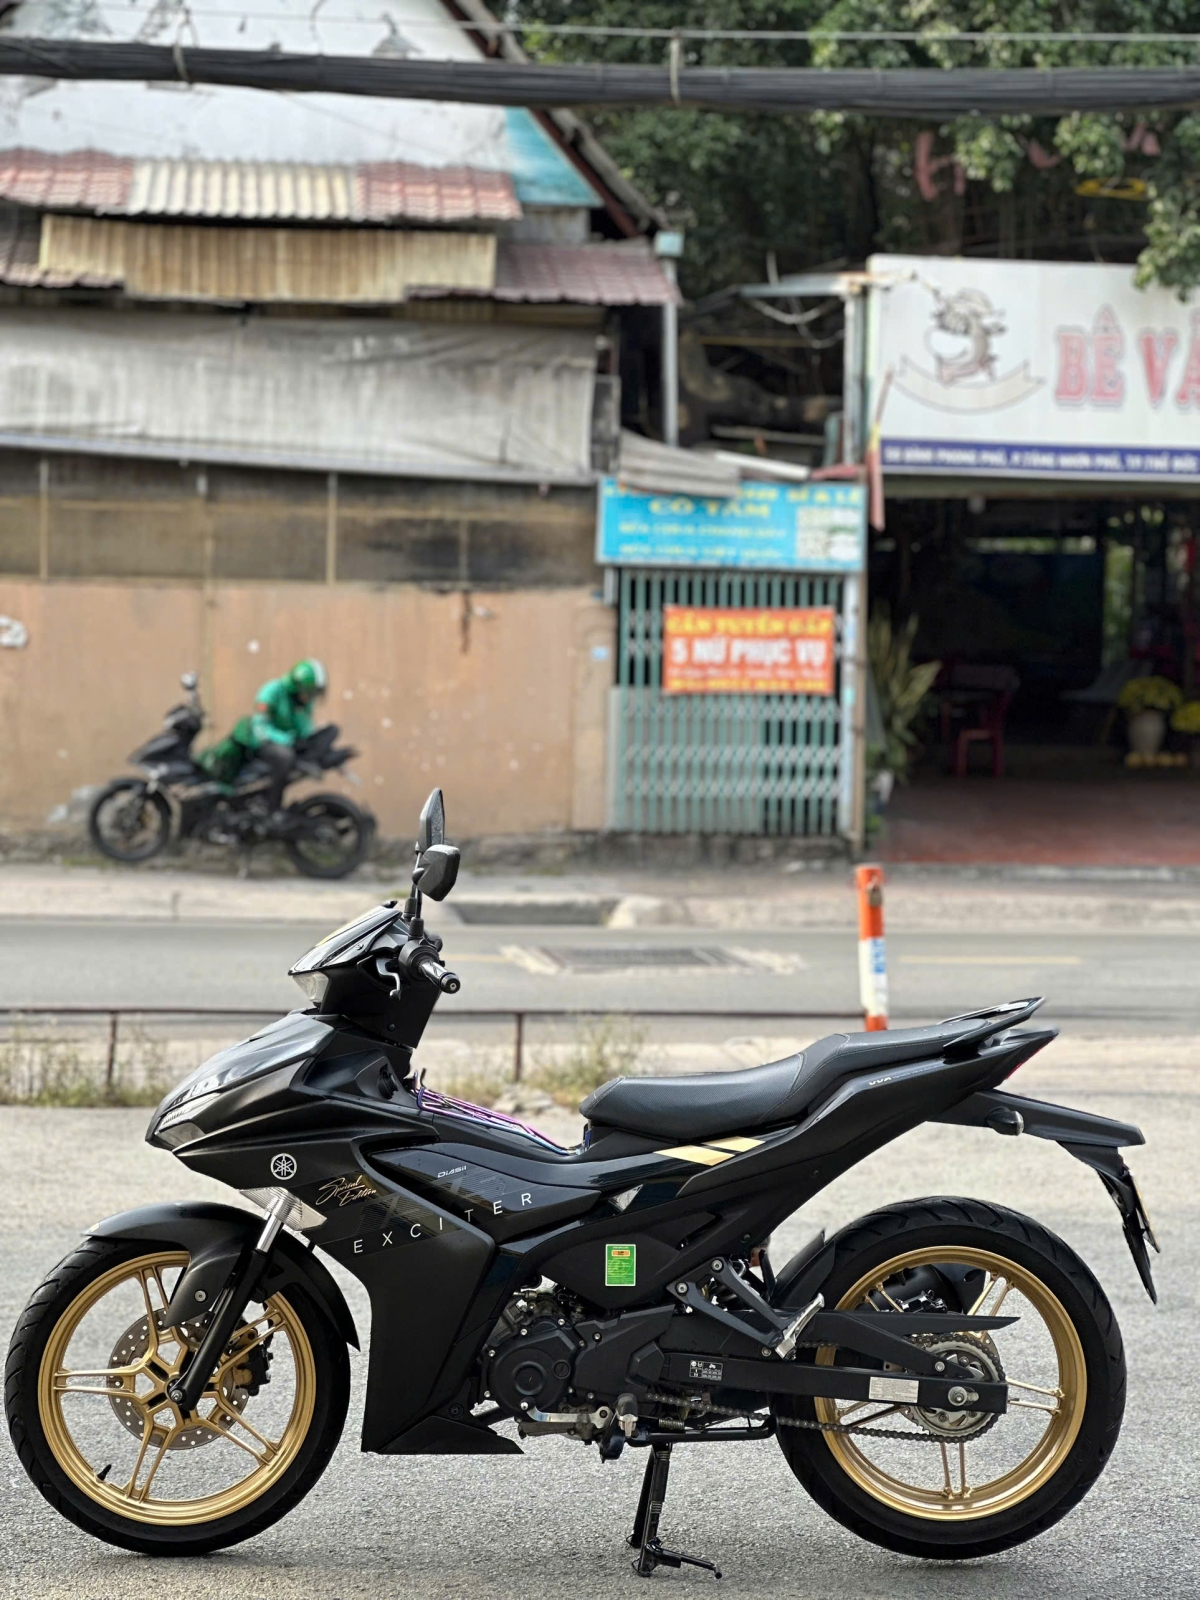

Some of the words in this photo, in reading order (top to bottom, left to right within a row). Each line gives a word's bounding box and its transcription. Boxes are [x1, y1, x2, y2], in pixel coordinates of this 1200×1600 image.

[315, 1174, 363, 1206] Special
[337, 1184, 377, 1207] Edition
[353, 1192, 533, 1254] EXCITER
